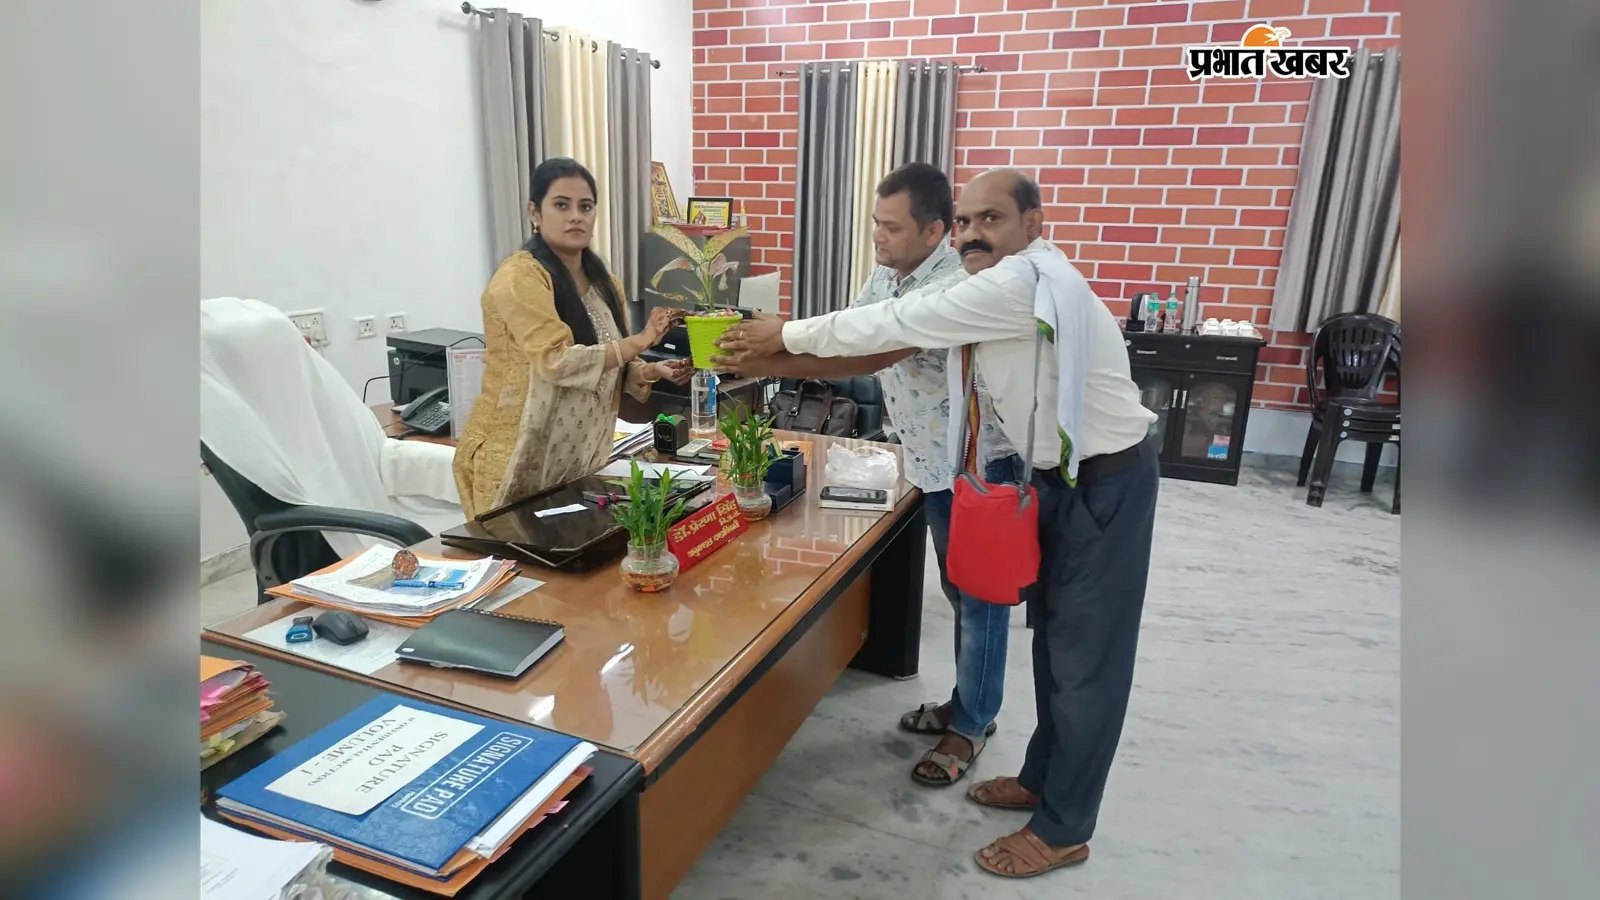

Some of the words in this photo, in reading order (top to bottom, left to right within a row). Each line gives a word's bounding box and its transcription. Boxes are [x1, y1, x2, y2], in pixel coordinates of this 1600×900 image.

[322, 718, 397, 763] VOLUME
[355, 731, 449, 794] SIGNATURE
[368, 744, 404, 767] PAD
[441, 736, 522, 790] SIGNATURE
[413, 787, 455, 813] PAD
